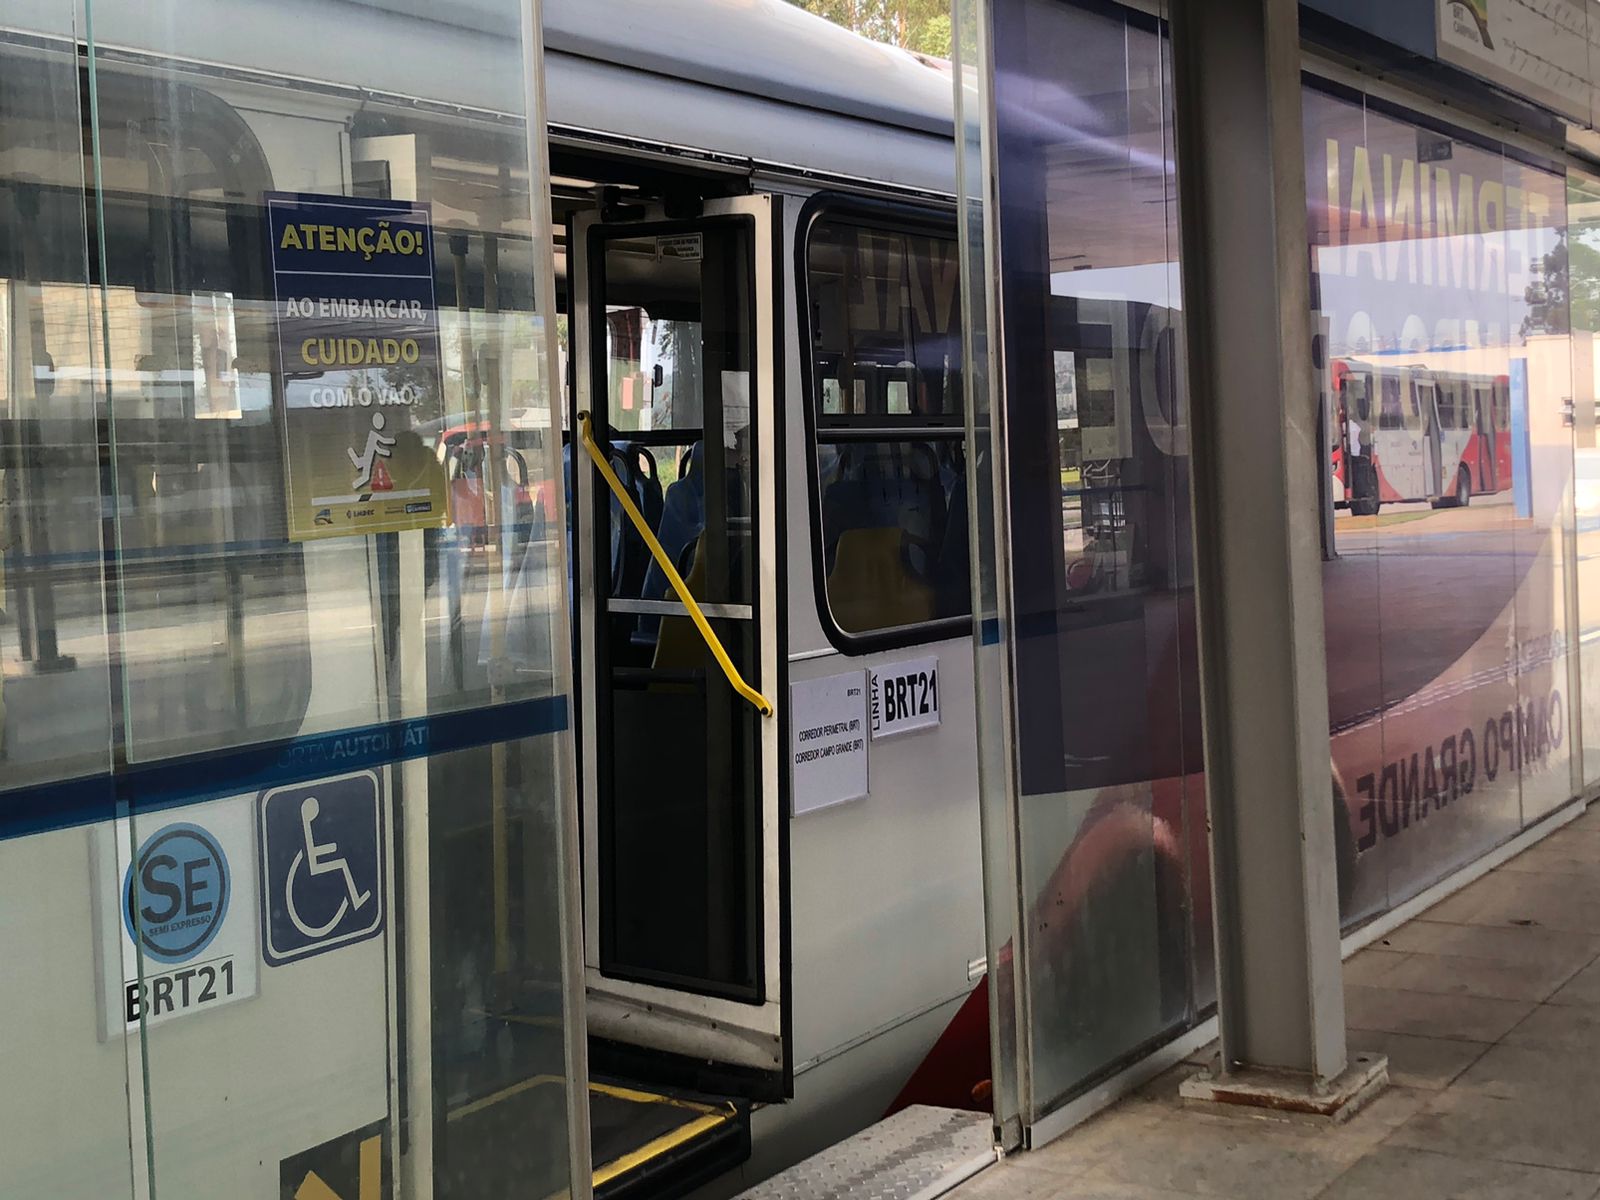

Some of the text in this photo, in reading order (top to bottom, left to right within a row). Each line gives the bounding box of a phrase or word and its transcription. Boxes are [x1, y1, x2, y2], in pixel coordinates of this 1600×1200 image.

[280, 221, 424, 261] ATENÇÃO!
[286, 297, 427, 322] AO EMBARCAR,
[301, 337, 420, 366] CUIDADO
[310, 387, 354, 408] COM
[358, 387, 373, 407] O
[871, 674, 880, 731] LINHA
[884, 670, 937, 722] BRT21
[799, 726, 824, 742] CORREDOR
[795, 748, 820, 764] CORREDOR
[140, 853, 213, 924] SE
[149, 914, 211, 937] SEMI EXPRESSO
[126, 960, 234, 1022] BRT21
